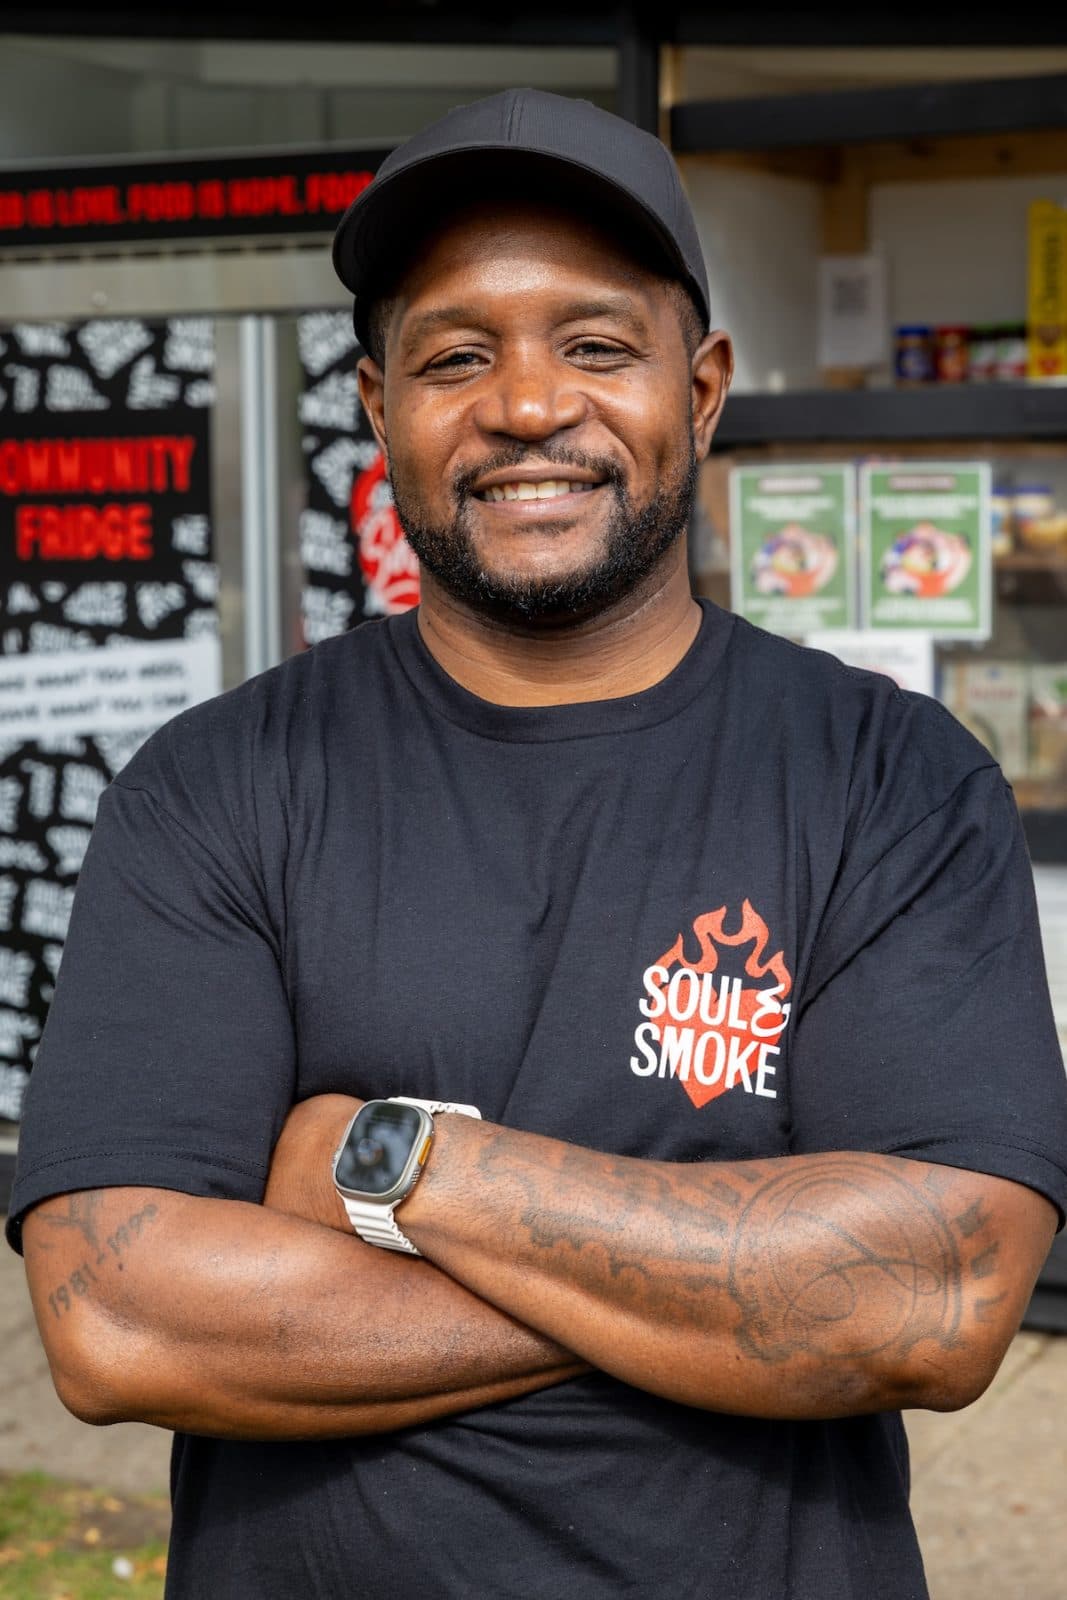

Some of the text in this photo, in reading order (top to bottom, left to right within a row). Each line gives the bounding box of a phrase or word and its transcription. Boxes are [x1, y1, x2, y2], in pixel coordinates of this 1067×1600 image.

[127, 181, 195, 222] FOOD
[16, 503, 153, 560] FRIDGE
[639, 965, 748, 1031] SOUL
[630, 1021, 781, 1098] SMOKE
